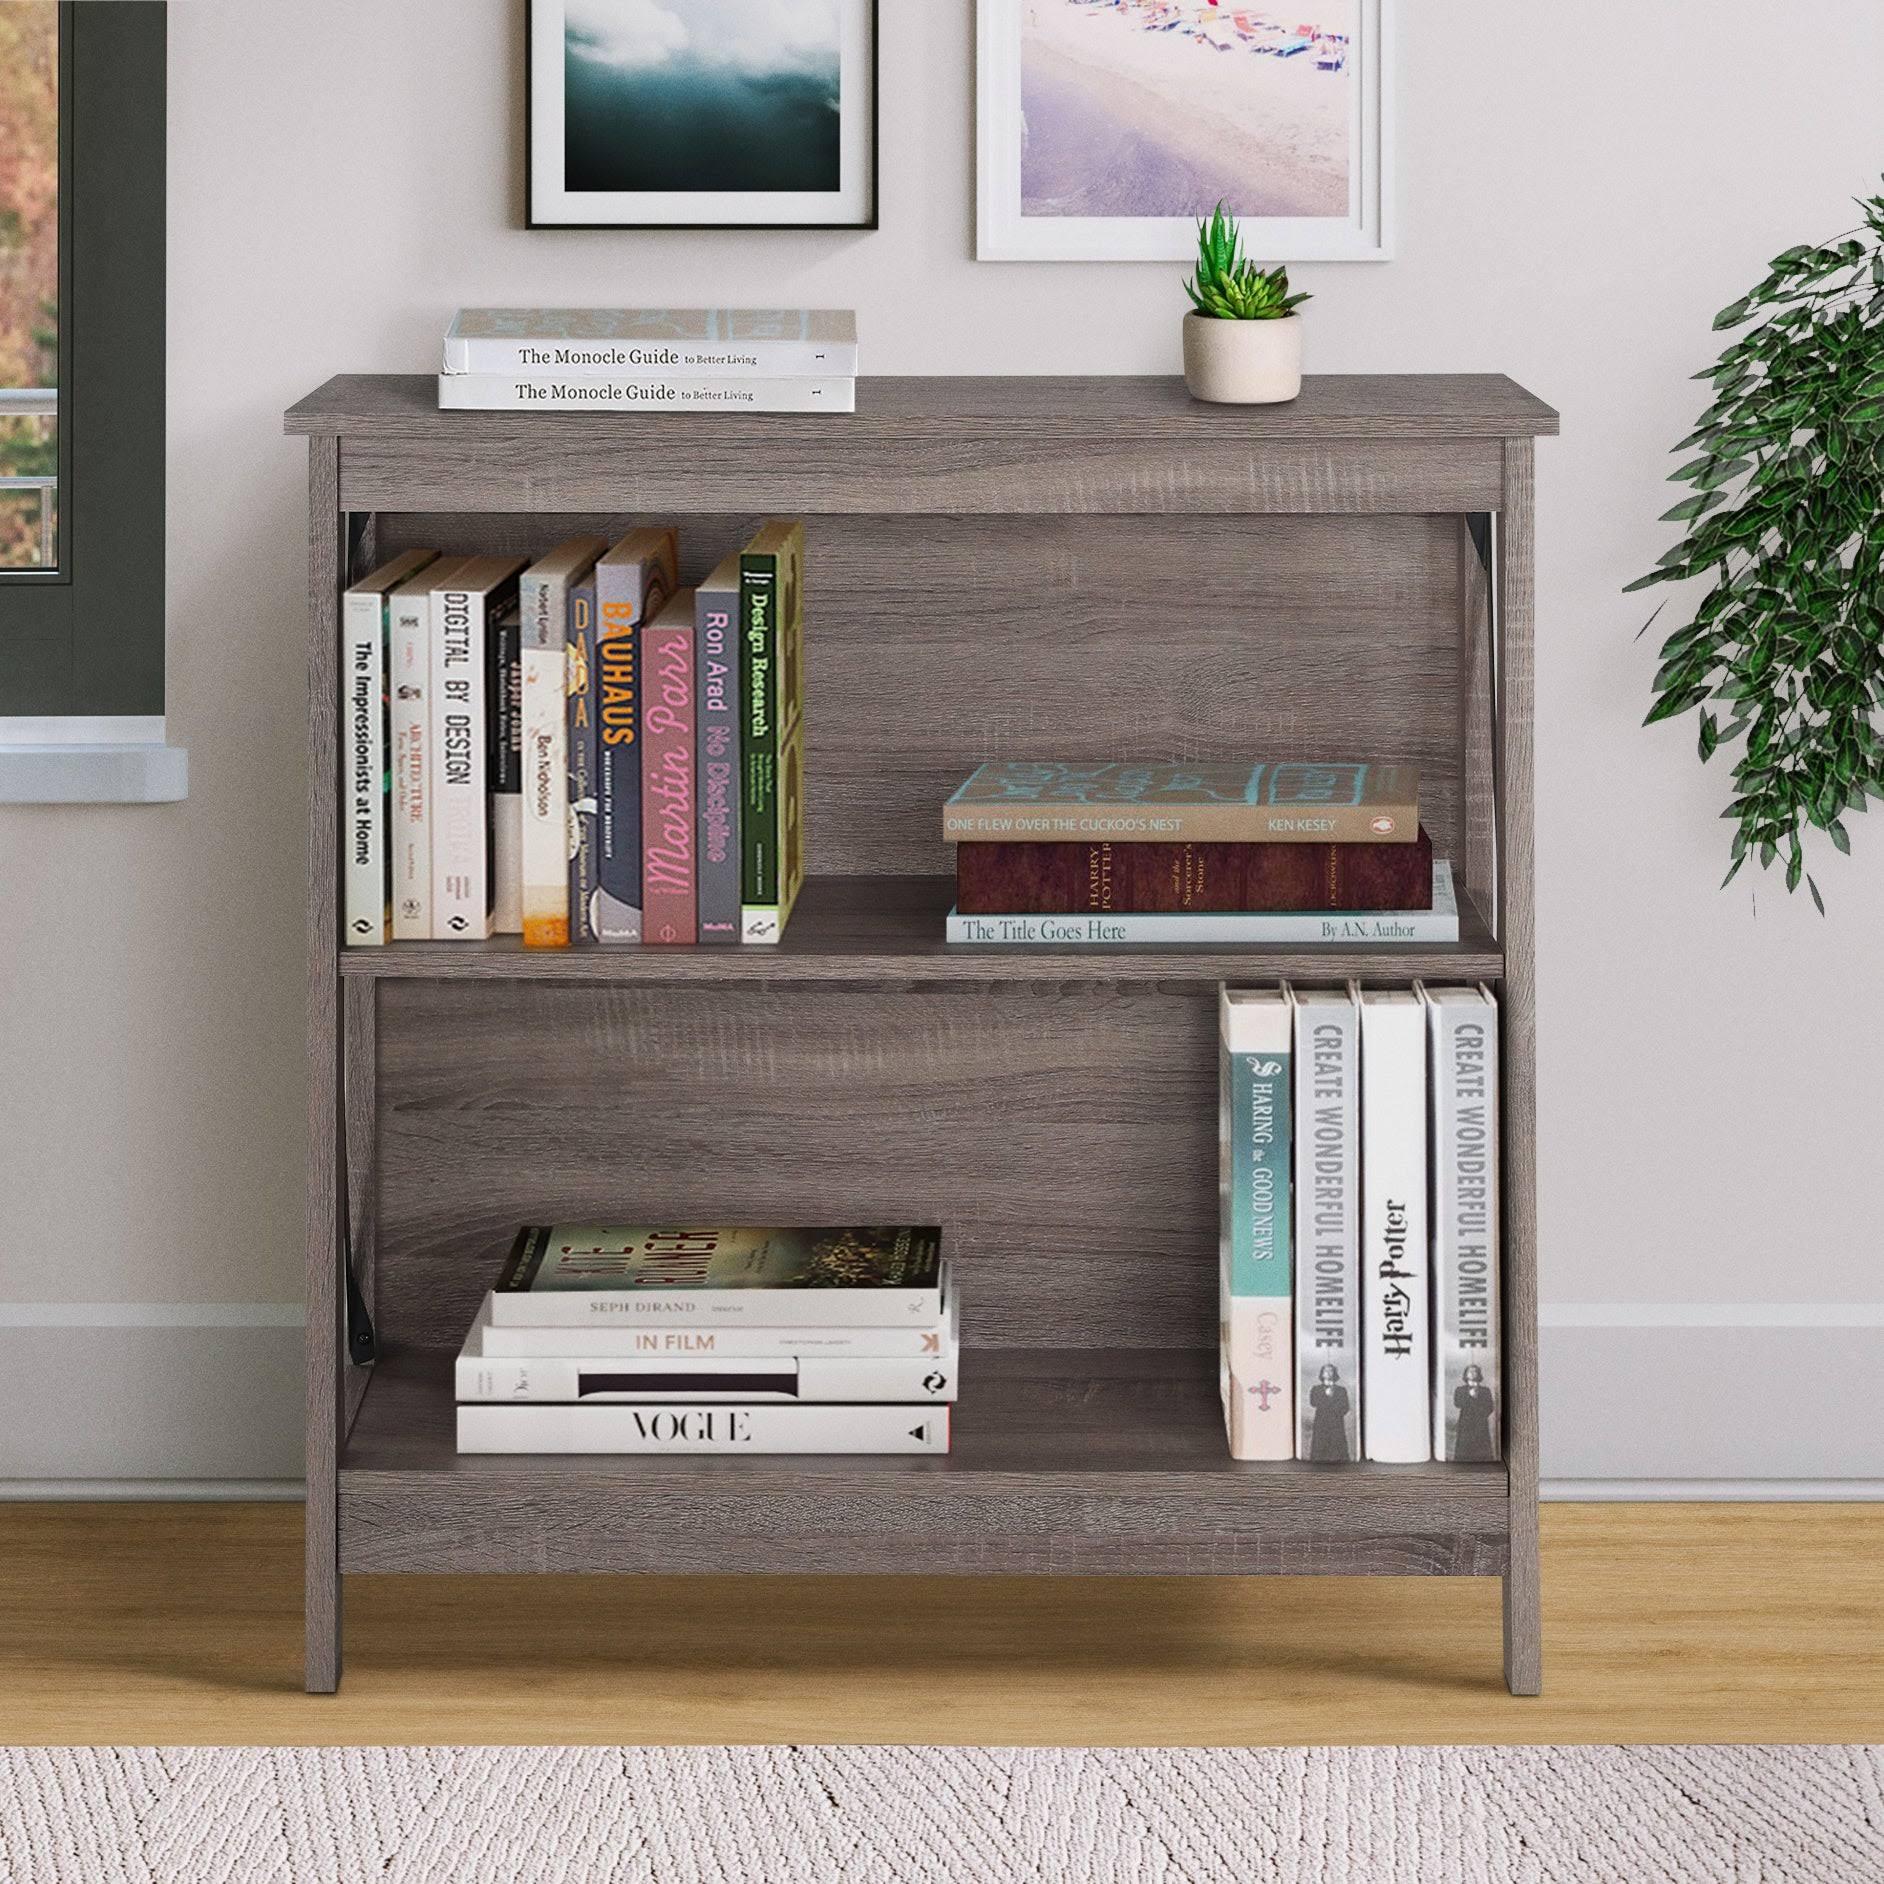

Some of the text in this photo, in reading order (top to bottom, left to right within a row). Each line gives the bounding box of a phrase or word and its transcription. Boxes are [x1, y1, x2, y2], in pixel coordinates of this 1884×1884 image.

[518, 348, 758, 367] The Monocle Guide to Better Living
[515, 383, 755, 402] The Monocle Guide to Better Living
[748, 593, 769, 641] Design
[443, 592, 472, 785] DIGITAL BY DESIGN
[601, 601, 635, 746] BAUHAUS
[645, 634, 691, 735] Parr
[750, 651, 770, 738] Research
[352, 641, 373, 866] The Impressionists at Home
[706, 612, 733, 864] Ron Arad No Discipline
[536, 735, 552, 817] Ben Nicholson
[645, 746, 691, 888] Martin
[947, 816, 1182, 832] ONE FLEW OVER THE CUCKOO'S NEST
[1268, 816, 1337, 832] KEN KESEY
[1089, 848, 1100, 907] HARRY
[1101, 843, 1112, 910] POTTER
[1172, 859, 1181, 894] and the
[1194, 857, 1205, 895] Stone
[963, 919, 1127, 941] The Title Goes Here
[1321, 921, 1416, 942] By A.N. Author
[1313, 1024, 1344, 1350] CREATE WONDERFUL HOMELIFE
[1454, 1024, 1488, 1350] CREATE WONDERFUL HOMELIFE
[554, 1246, 634, 1277] KITE
[634, 1231, 720, 1285] RUNNER
[1378, 1198, 1418, 1360] Harry Potter
[589, 1301, 630, 1313] SEPH
[635, 1334, 716, 1351] IN FILM
[1252, 1311, 1277, 1362] Casey
[632, 1411, 752, 1442] VOGUE
